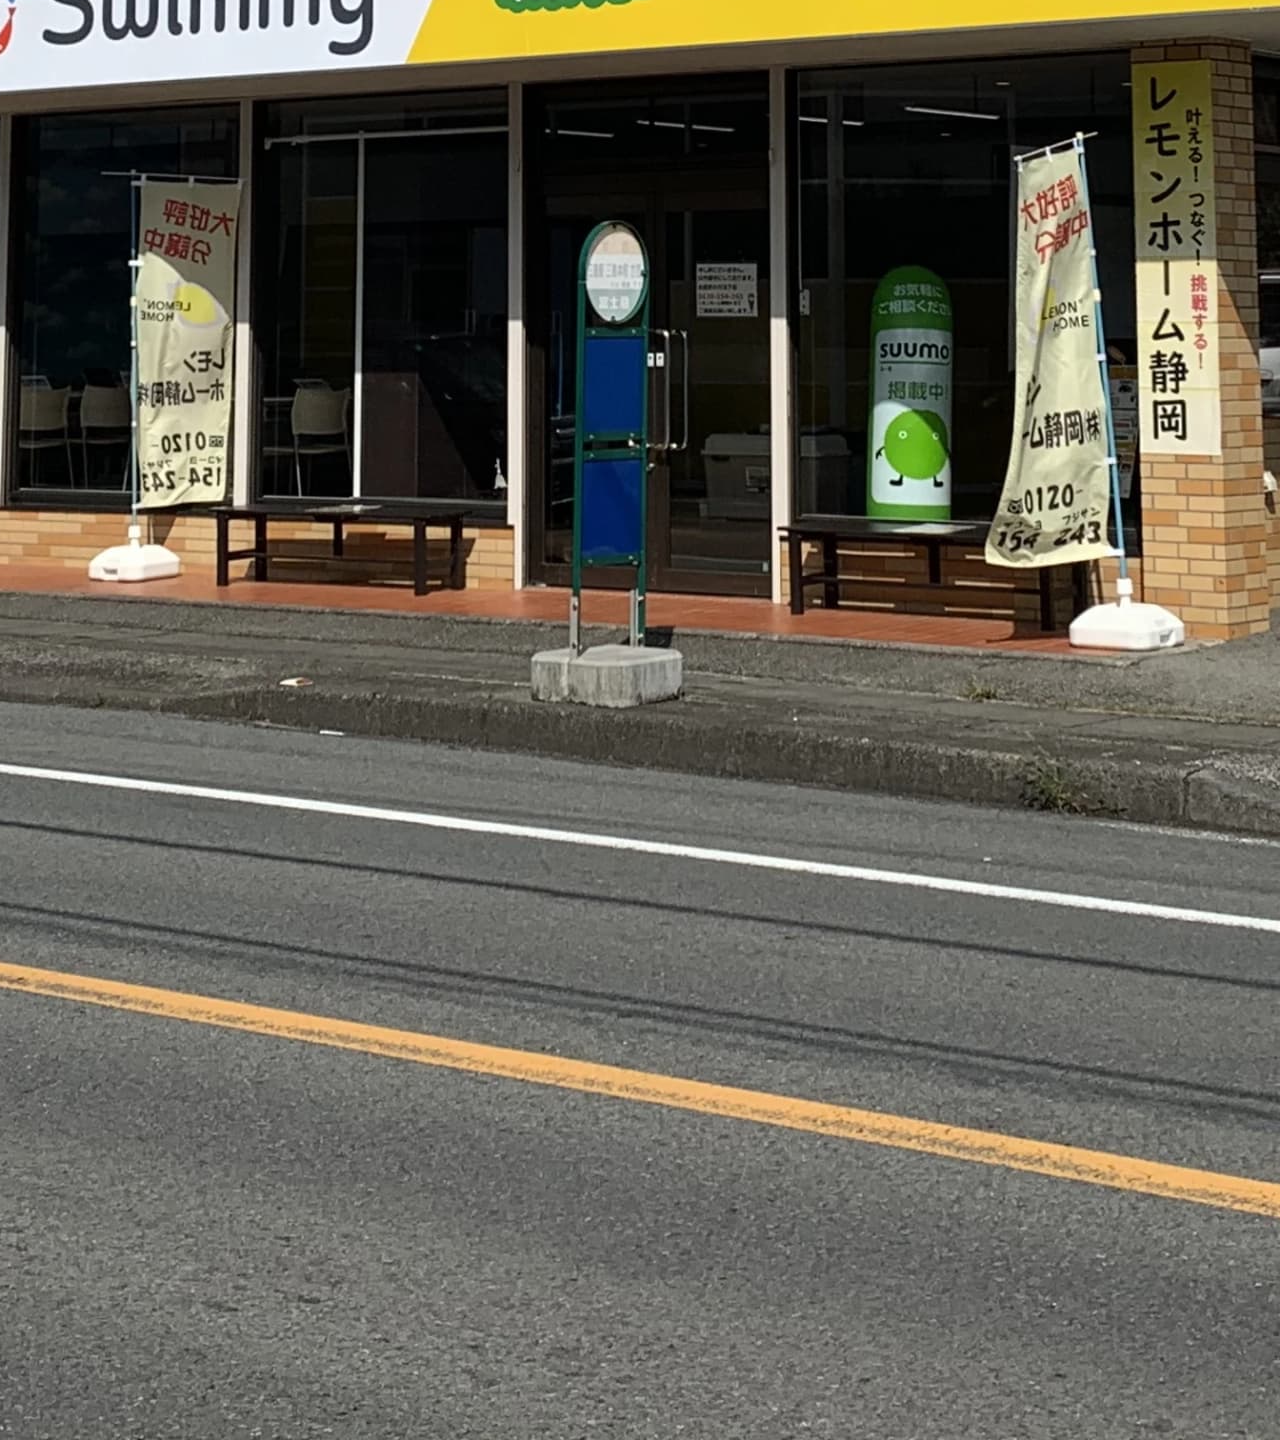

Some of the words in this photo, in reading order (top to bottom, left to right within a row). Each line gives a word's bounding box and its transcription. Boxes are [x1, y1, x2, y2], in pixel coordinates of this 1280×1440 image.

[1020, 173, 1078, 232] 大好評
[1145, 77, 1189, 441] レモンホーム静岡
